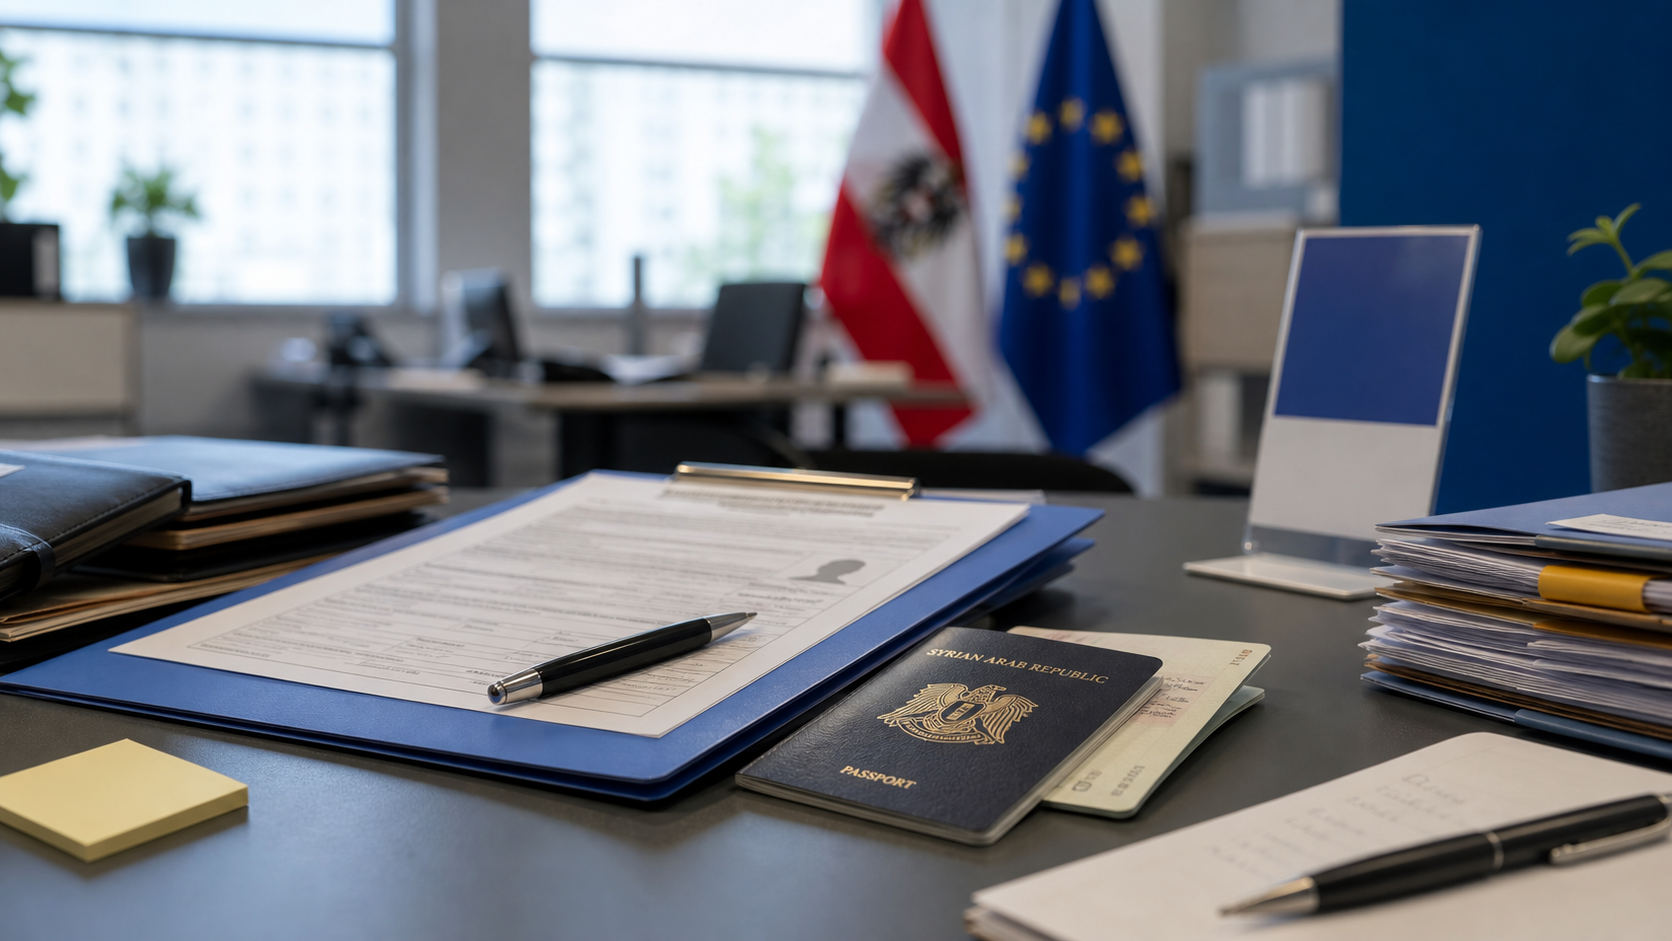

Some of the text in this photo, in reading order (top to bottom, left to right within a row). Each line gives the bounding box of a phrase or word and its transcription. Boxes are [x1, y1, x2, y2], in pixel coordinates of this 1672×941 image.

[926, 648, 1109, 684] SYRIAN ARAB REPUBLIC
[840, 765, 917, 789] PASSPORT
